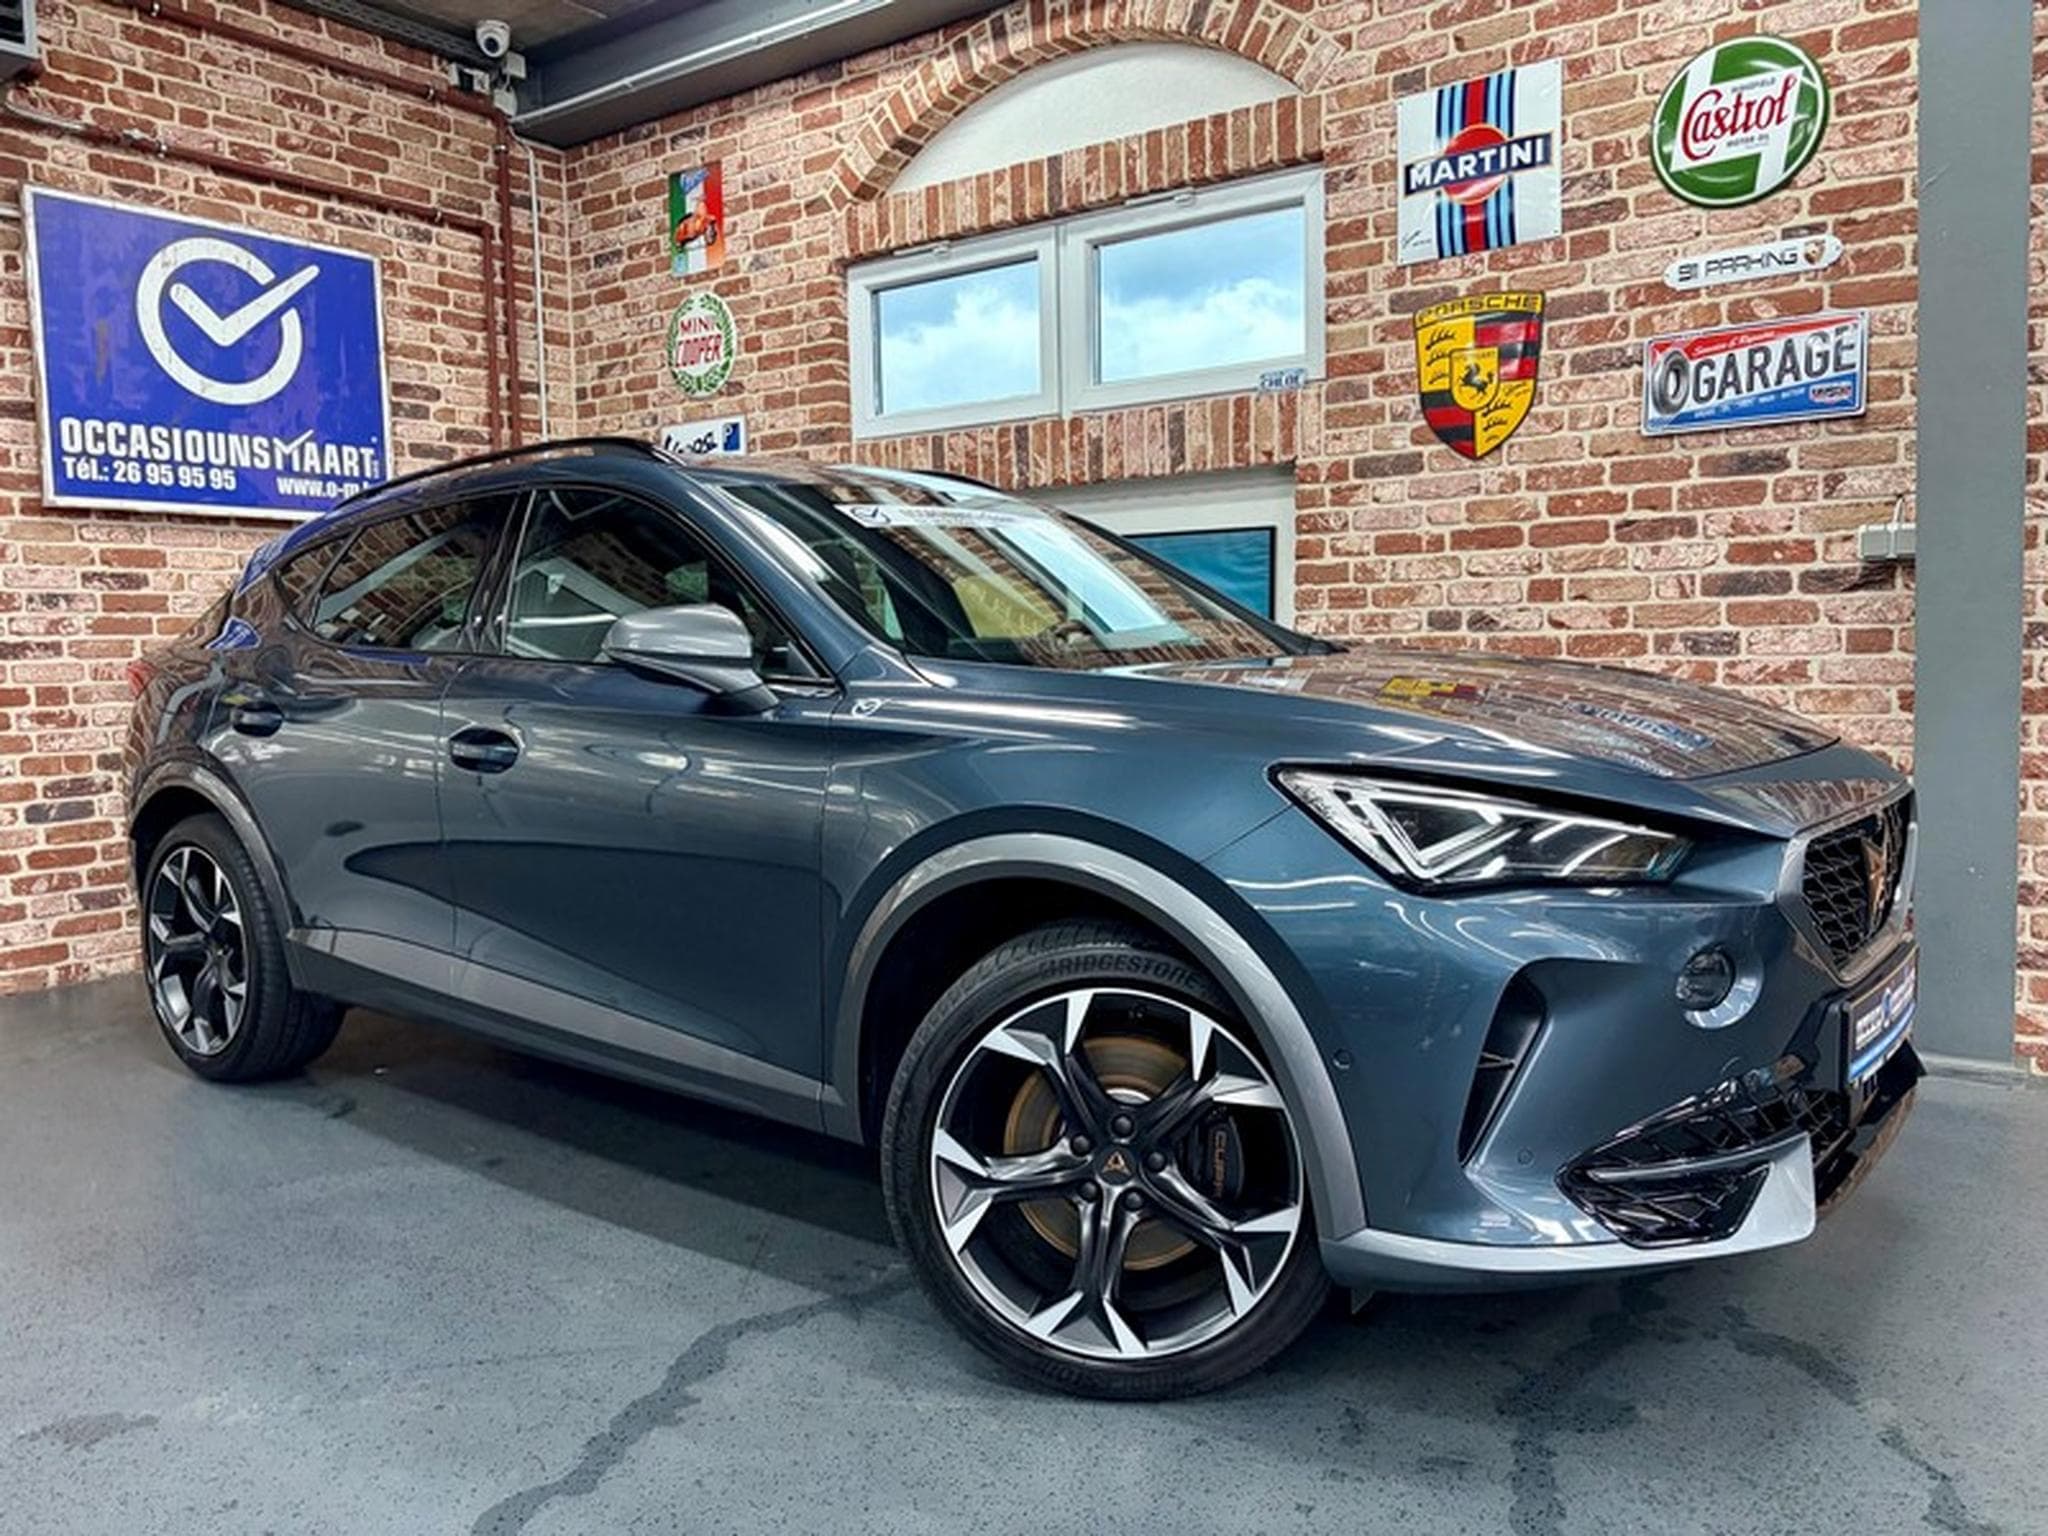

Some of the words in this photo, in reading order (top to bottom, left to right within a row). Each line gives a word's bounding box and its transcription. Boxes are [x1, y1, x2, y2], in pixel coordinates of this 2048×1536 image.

[1682, 74, 1798, 161] Castrol
[1410, 138, 1544, 190] MARTINI
[1704, 247, 1798, 276] PARKING
[1418, 295, 1539, 322] PORSCHE
[681, 317, 714, 336] MINI
[675, 334, 722, 368] COOPER
[1692, 322, 1858, 404] GARAGE
[62, 456, 110, 482] Tél.:
[113, 459, 142, 484] 26
[145, 462, 174, 487] 95
[178, 464, 206, 489] 95
[209, 467, 237, 492] 95
[276, 476, 370, 499] www.o-m
[1039, 953, 1201, 990] BRIDGESTONE
